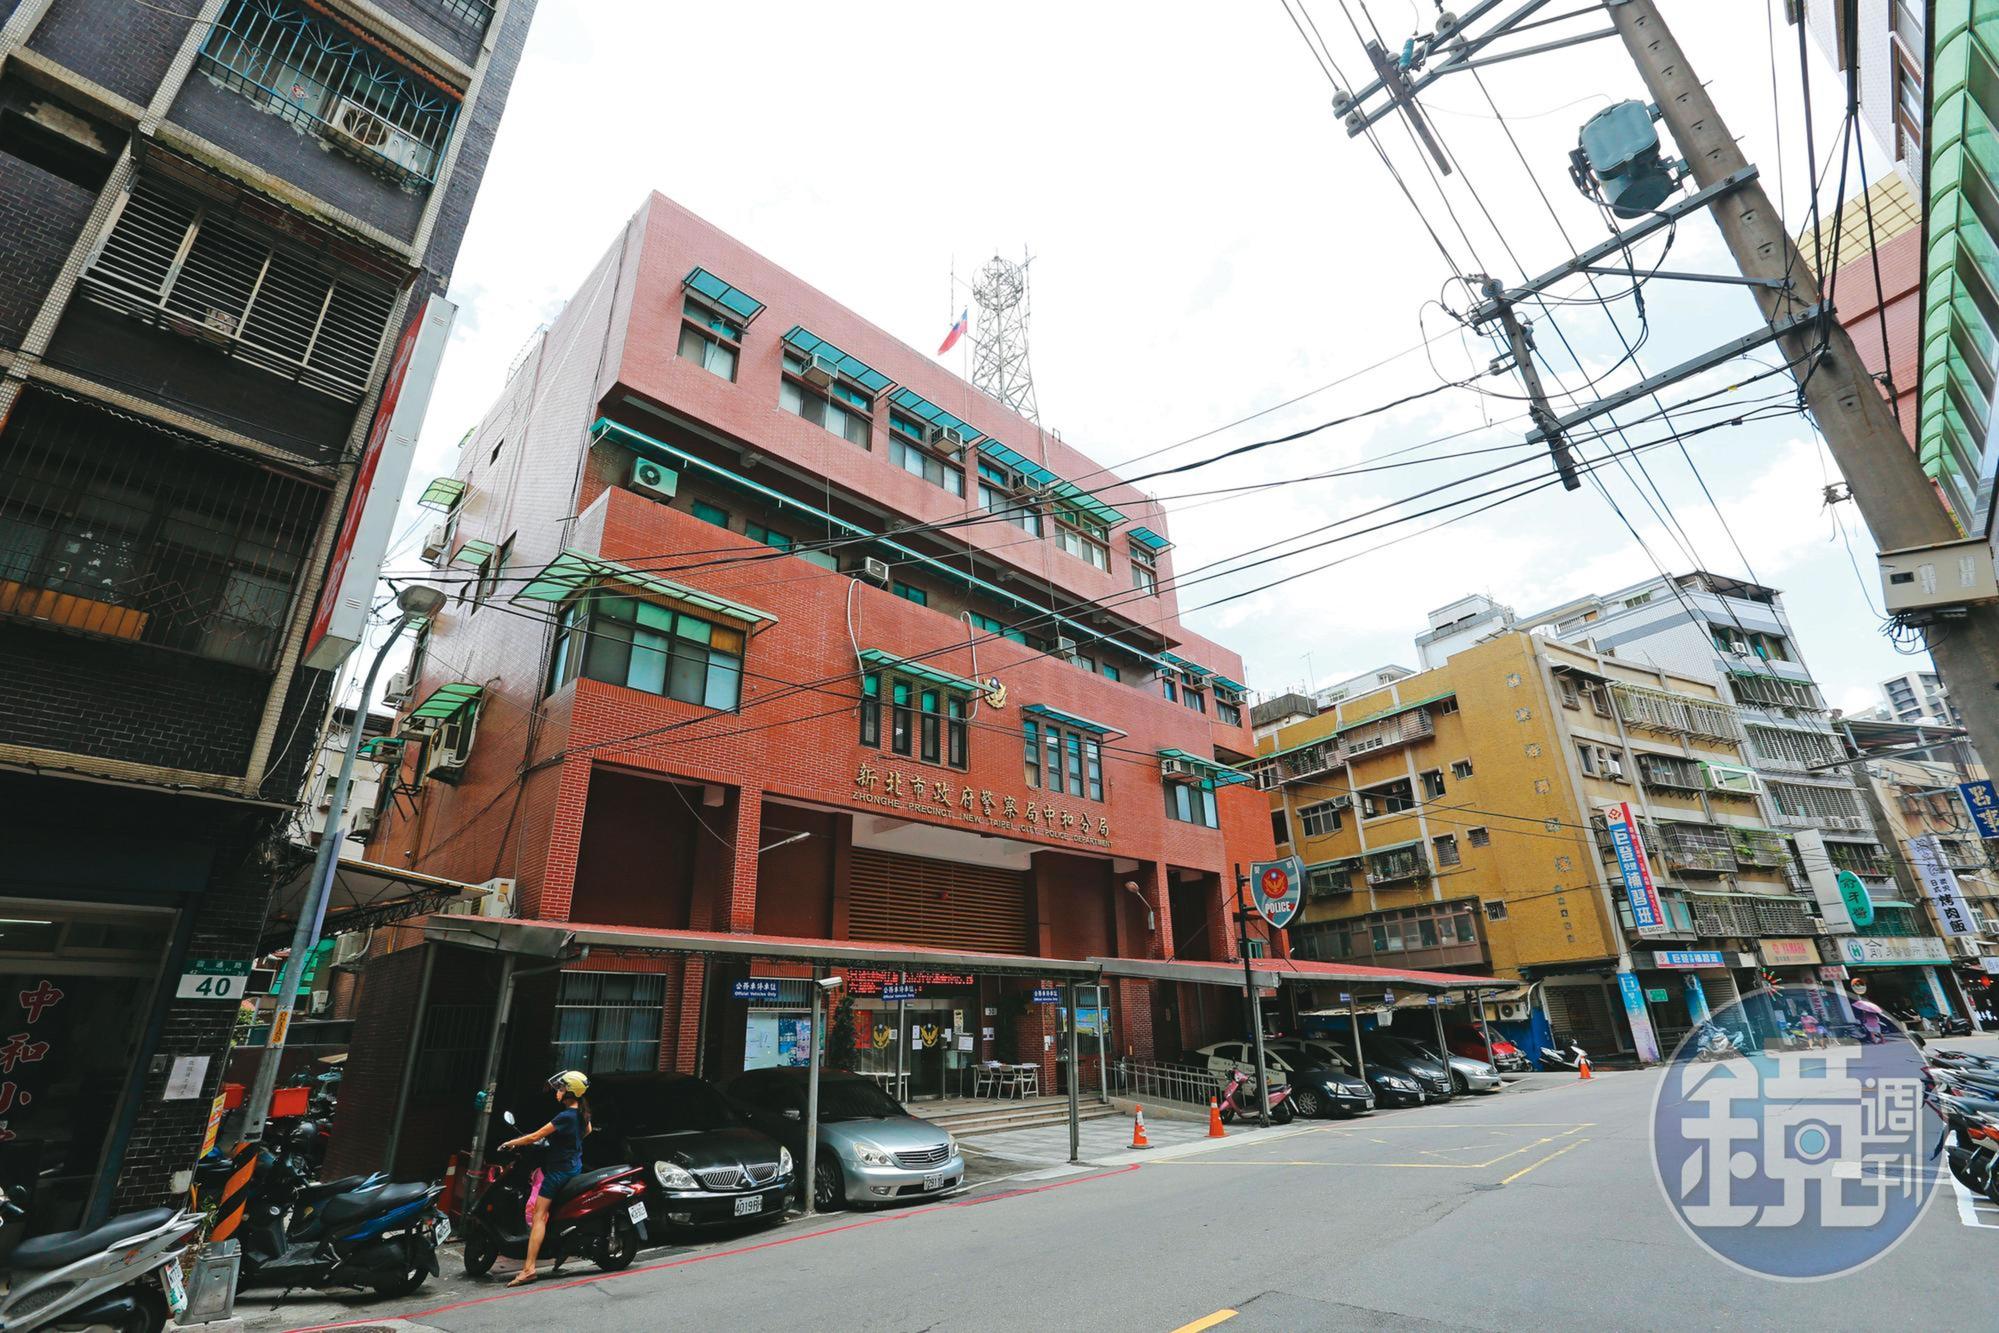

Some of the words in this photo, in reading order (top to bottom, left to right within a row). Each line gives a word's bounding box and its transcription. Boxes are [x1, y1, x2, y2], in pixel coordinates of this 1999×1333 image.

[852, 791, 900, 809] ZHONGHE
[963, 813, 983, 824] NEW
[1020, 824, 1039, 835] CITY
[1044, 829, 1069, 841] POLICE
[1073, 834, 1114, 849] DEPARTMENT
[855, 762, 1110, 838] 新北市政府警察局中和分局
[1264, 901, 1290, 914] POLICE
[195, 977, 231, 997] 40
[0, 980, 64, 1140] 中和小
